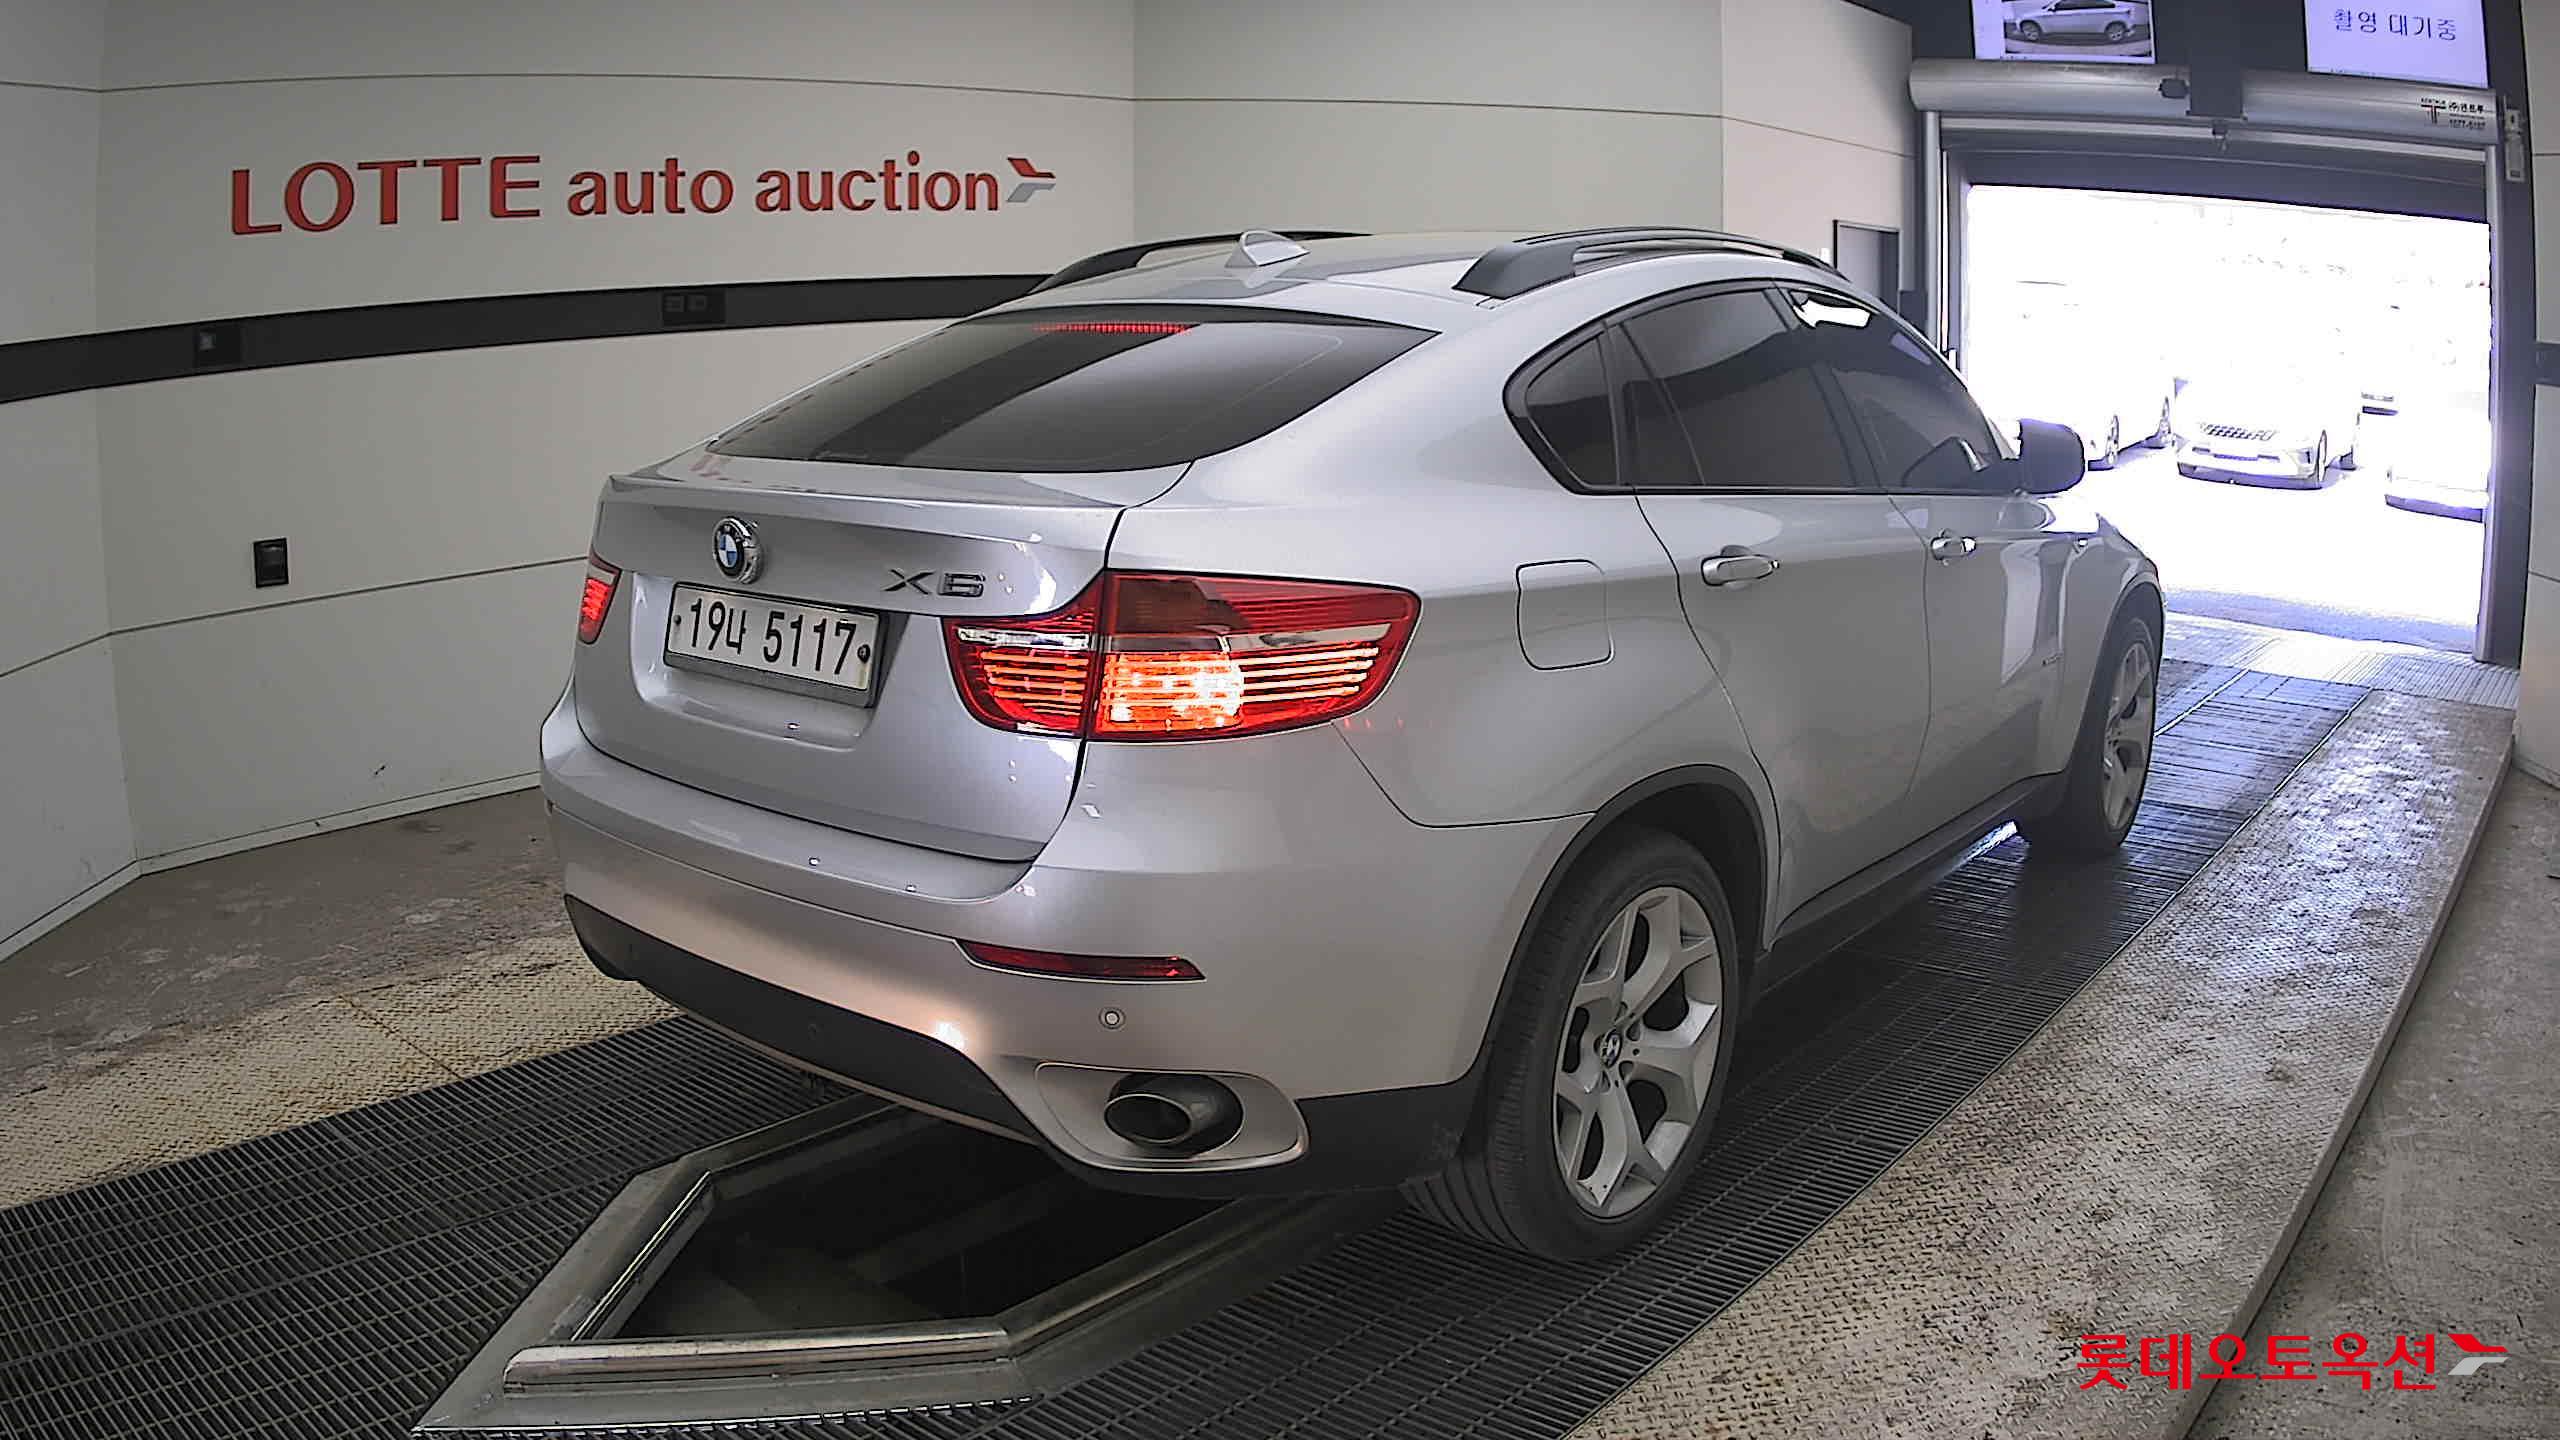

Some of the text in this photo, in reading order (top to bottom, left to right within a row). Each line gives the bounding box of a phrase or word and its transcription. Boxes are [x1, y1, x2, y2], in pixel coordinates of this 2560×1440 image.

[2389, 14, 2456, 41] 대기중
[231, 150, 1000, 235] LOTTE auto auction
[884, 569, 986, 598] X6
[690, 597, 857, 675] 19나 5117
